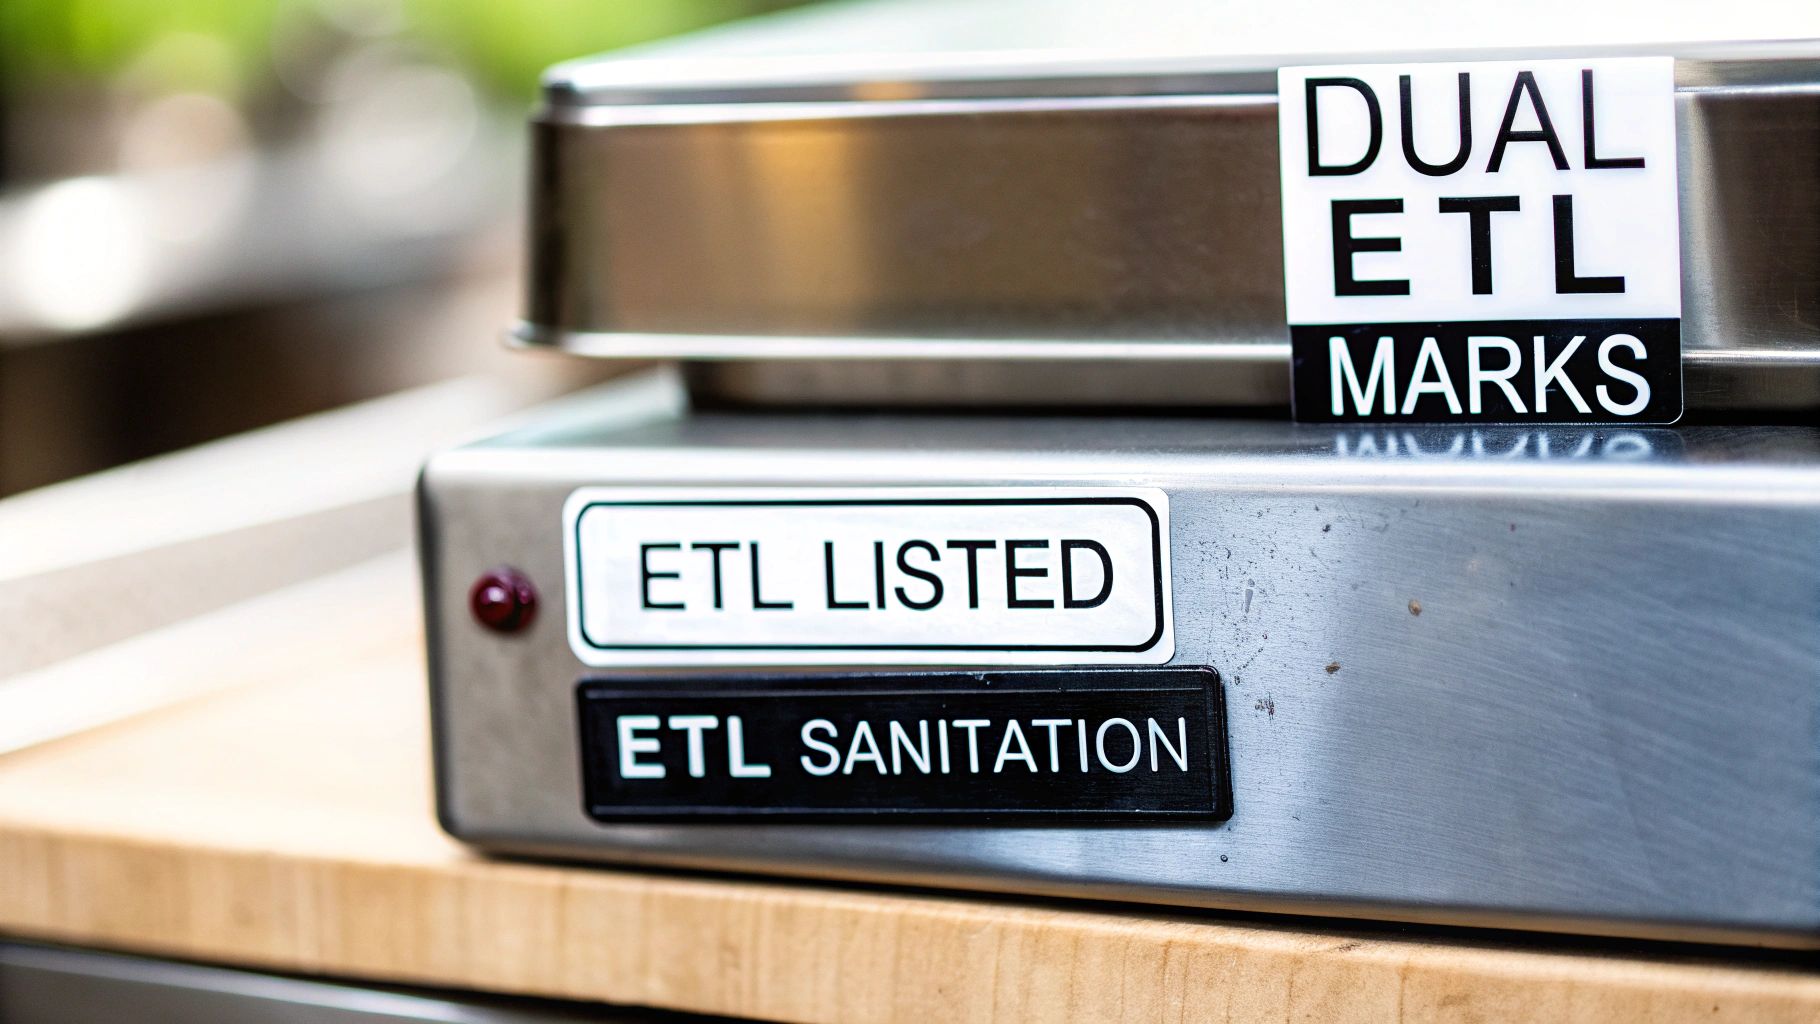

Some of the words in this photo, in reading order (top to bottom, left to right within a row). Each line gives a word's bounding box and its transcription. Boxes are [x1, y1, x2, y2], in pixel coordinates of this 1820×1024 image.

[1305, 69, 1645, 177] DUAL
[1330, 194, 1626, 297] ETL
[1328, 334, 1651, 417] MARKS
[639, 541, 794, 612] ETL
[824, 539, 1114, 611] LISTED
[616, 715, 772, 780] ETL
[800, 716, 1189, 777] SANITATION
